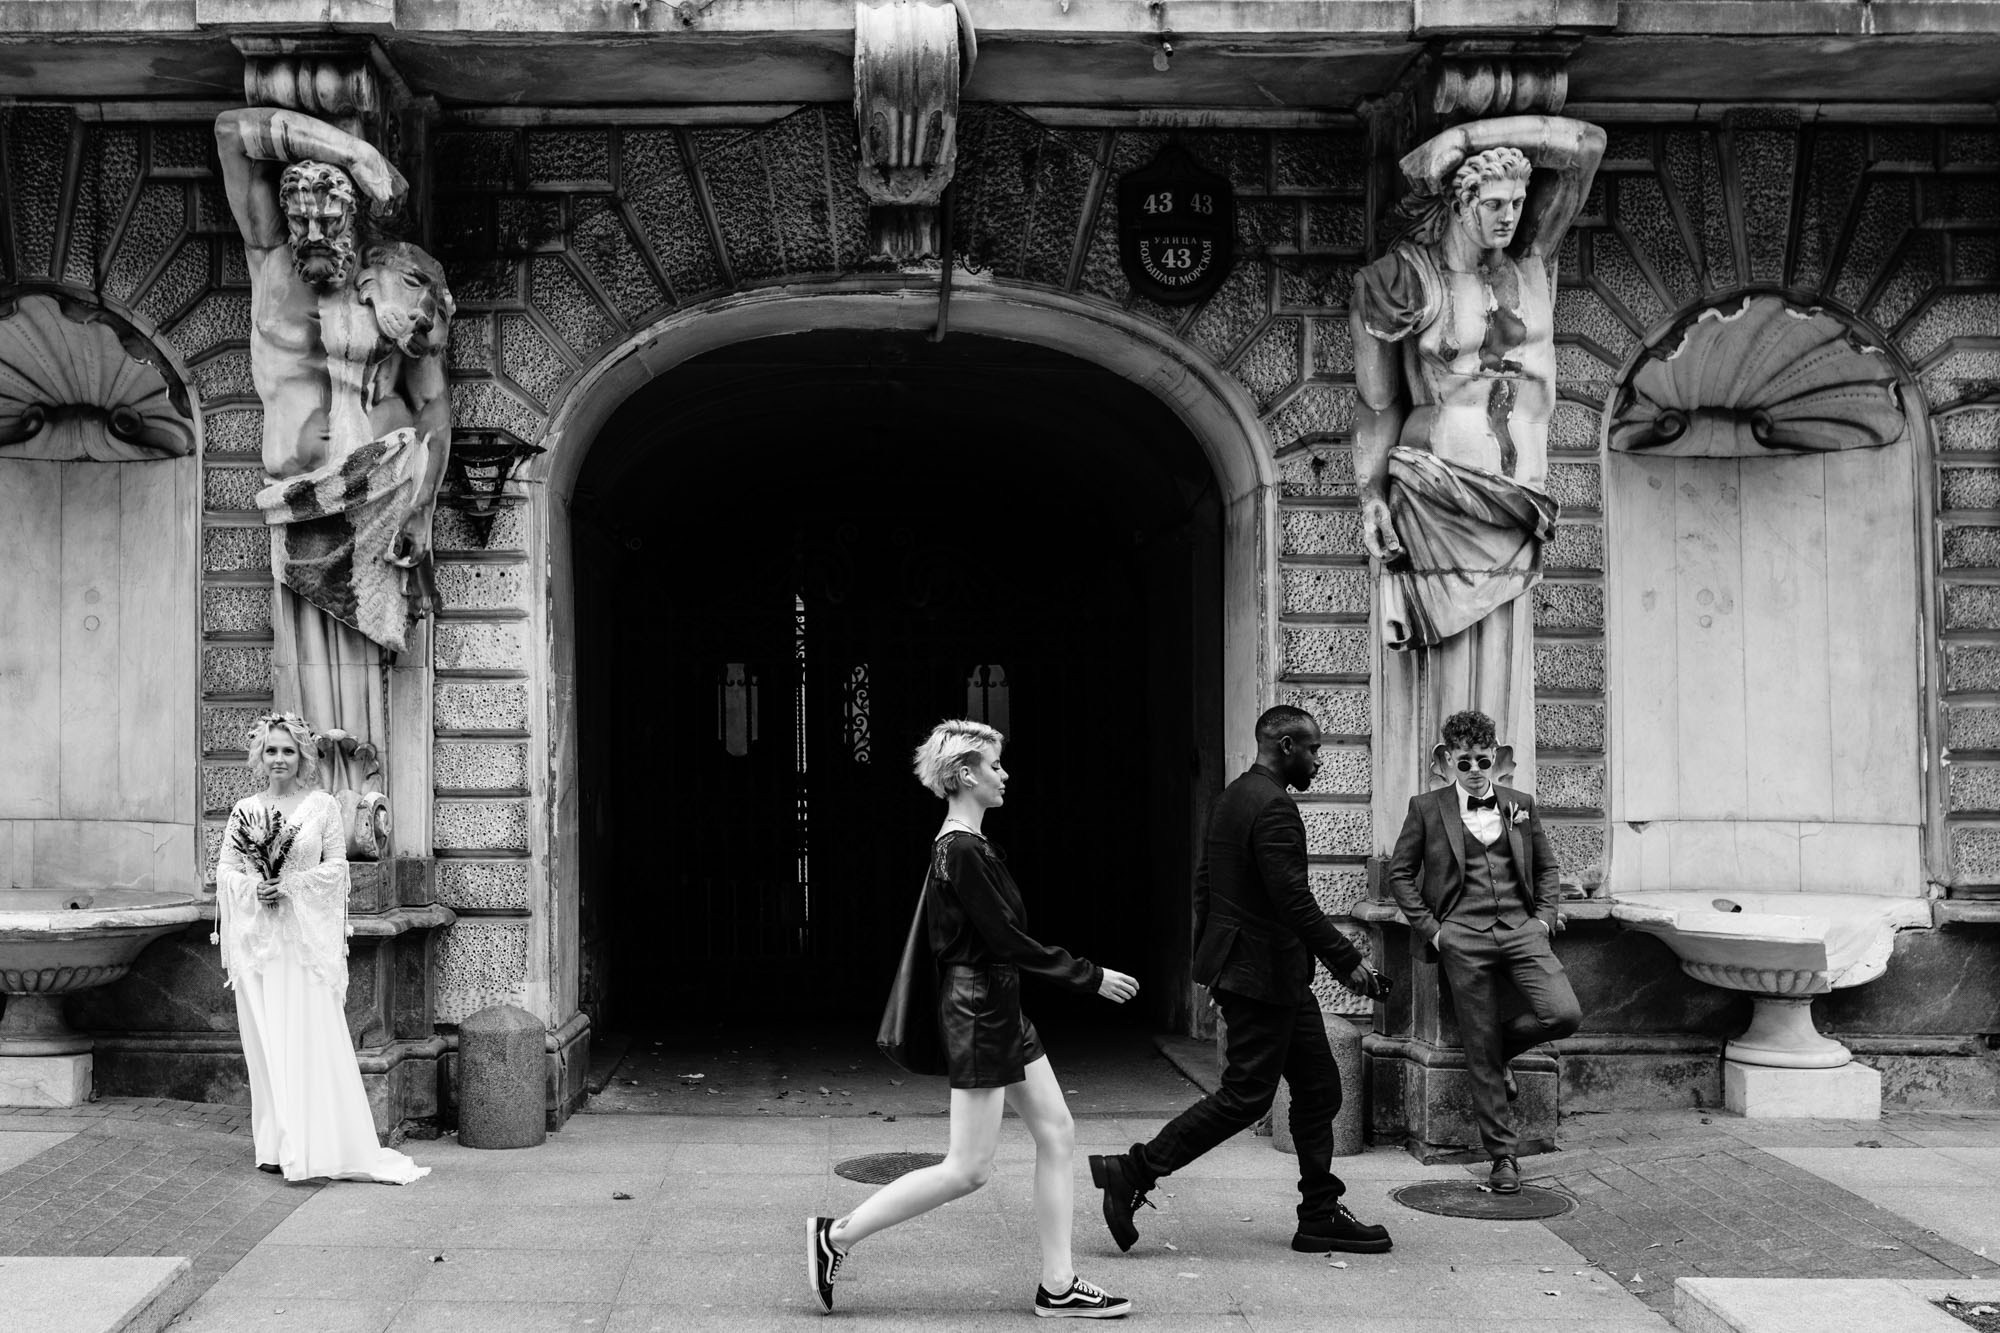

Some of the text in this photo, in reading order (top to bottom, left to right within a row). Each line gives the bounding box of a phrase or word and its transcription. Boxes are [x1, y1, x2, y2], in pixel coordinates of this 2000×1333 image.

[1143, 192, 1173, 214] 43
[1190, 193, 1213, 215] 43
[1154, 236, 1197, 245] УЛИЦА
[1140, 240, 1212, 286] БОЛЬШАЯ МОРСКАЯ
[1161, 248, 1191, 269] 43
